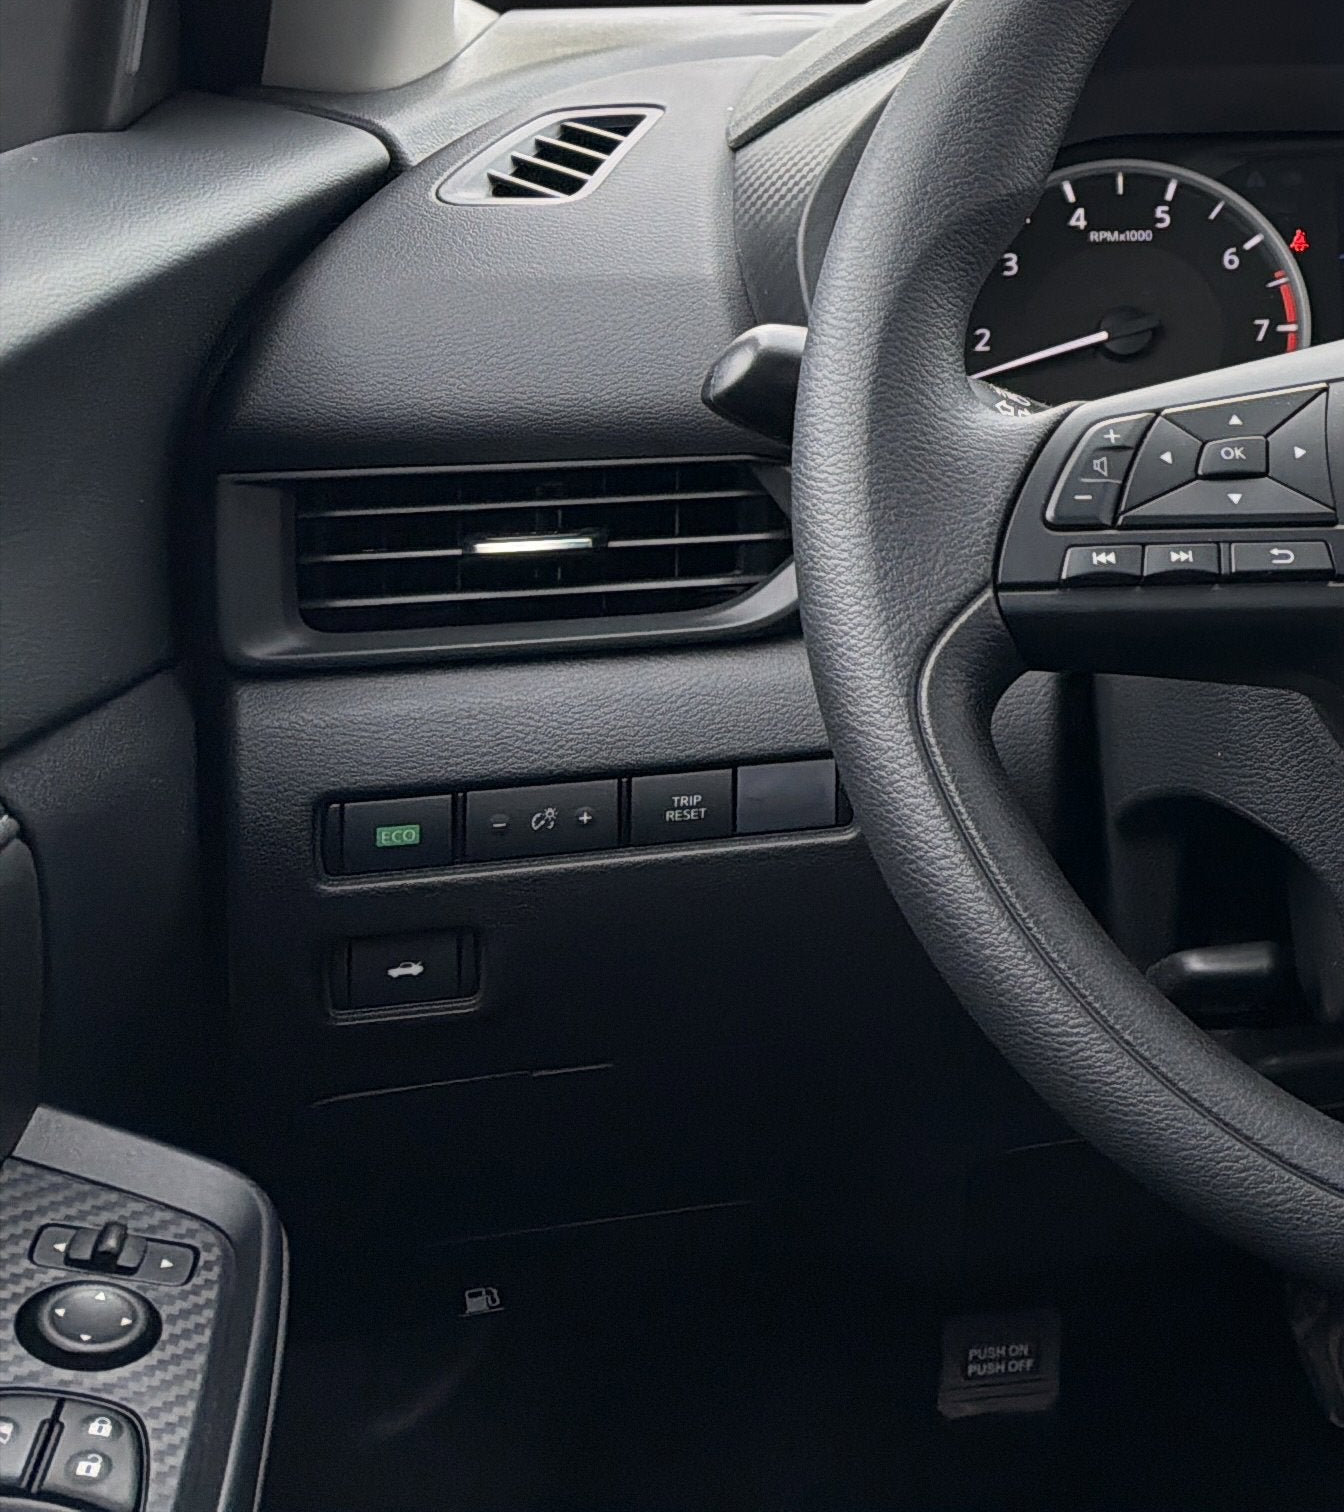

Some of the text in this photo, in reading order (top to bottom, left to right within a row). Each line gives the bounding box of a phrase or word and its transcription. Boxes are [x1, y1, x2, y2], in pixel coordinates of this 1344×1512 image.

[1069, 208, 1087, 230] 4
[1154, 205, 1171, 228] 5
[1002, 252, 1019, 277] 3
[1222, 248, 1240, 270] 6
[974, 327, 991, 352] 2
[1253, 319, 1270, 342] 7
[1220, 445, 1246, 461] OK
[672, 794, 702, 808] TRIP
[665, 807, 707, 822] RESET
[381, 829, 416, 844] ECO
[968, 1344, 1029, 1361] PUSH ON
[967, 1358, 1034, 1377] PUSH OFF
